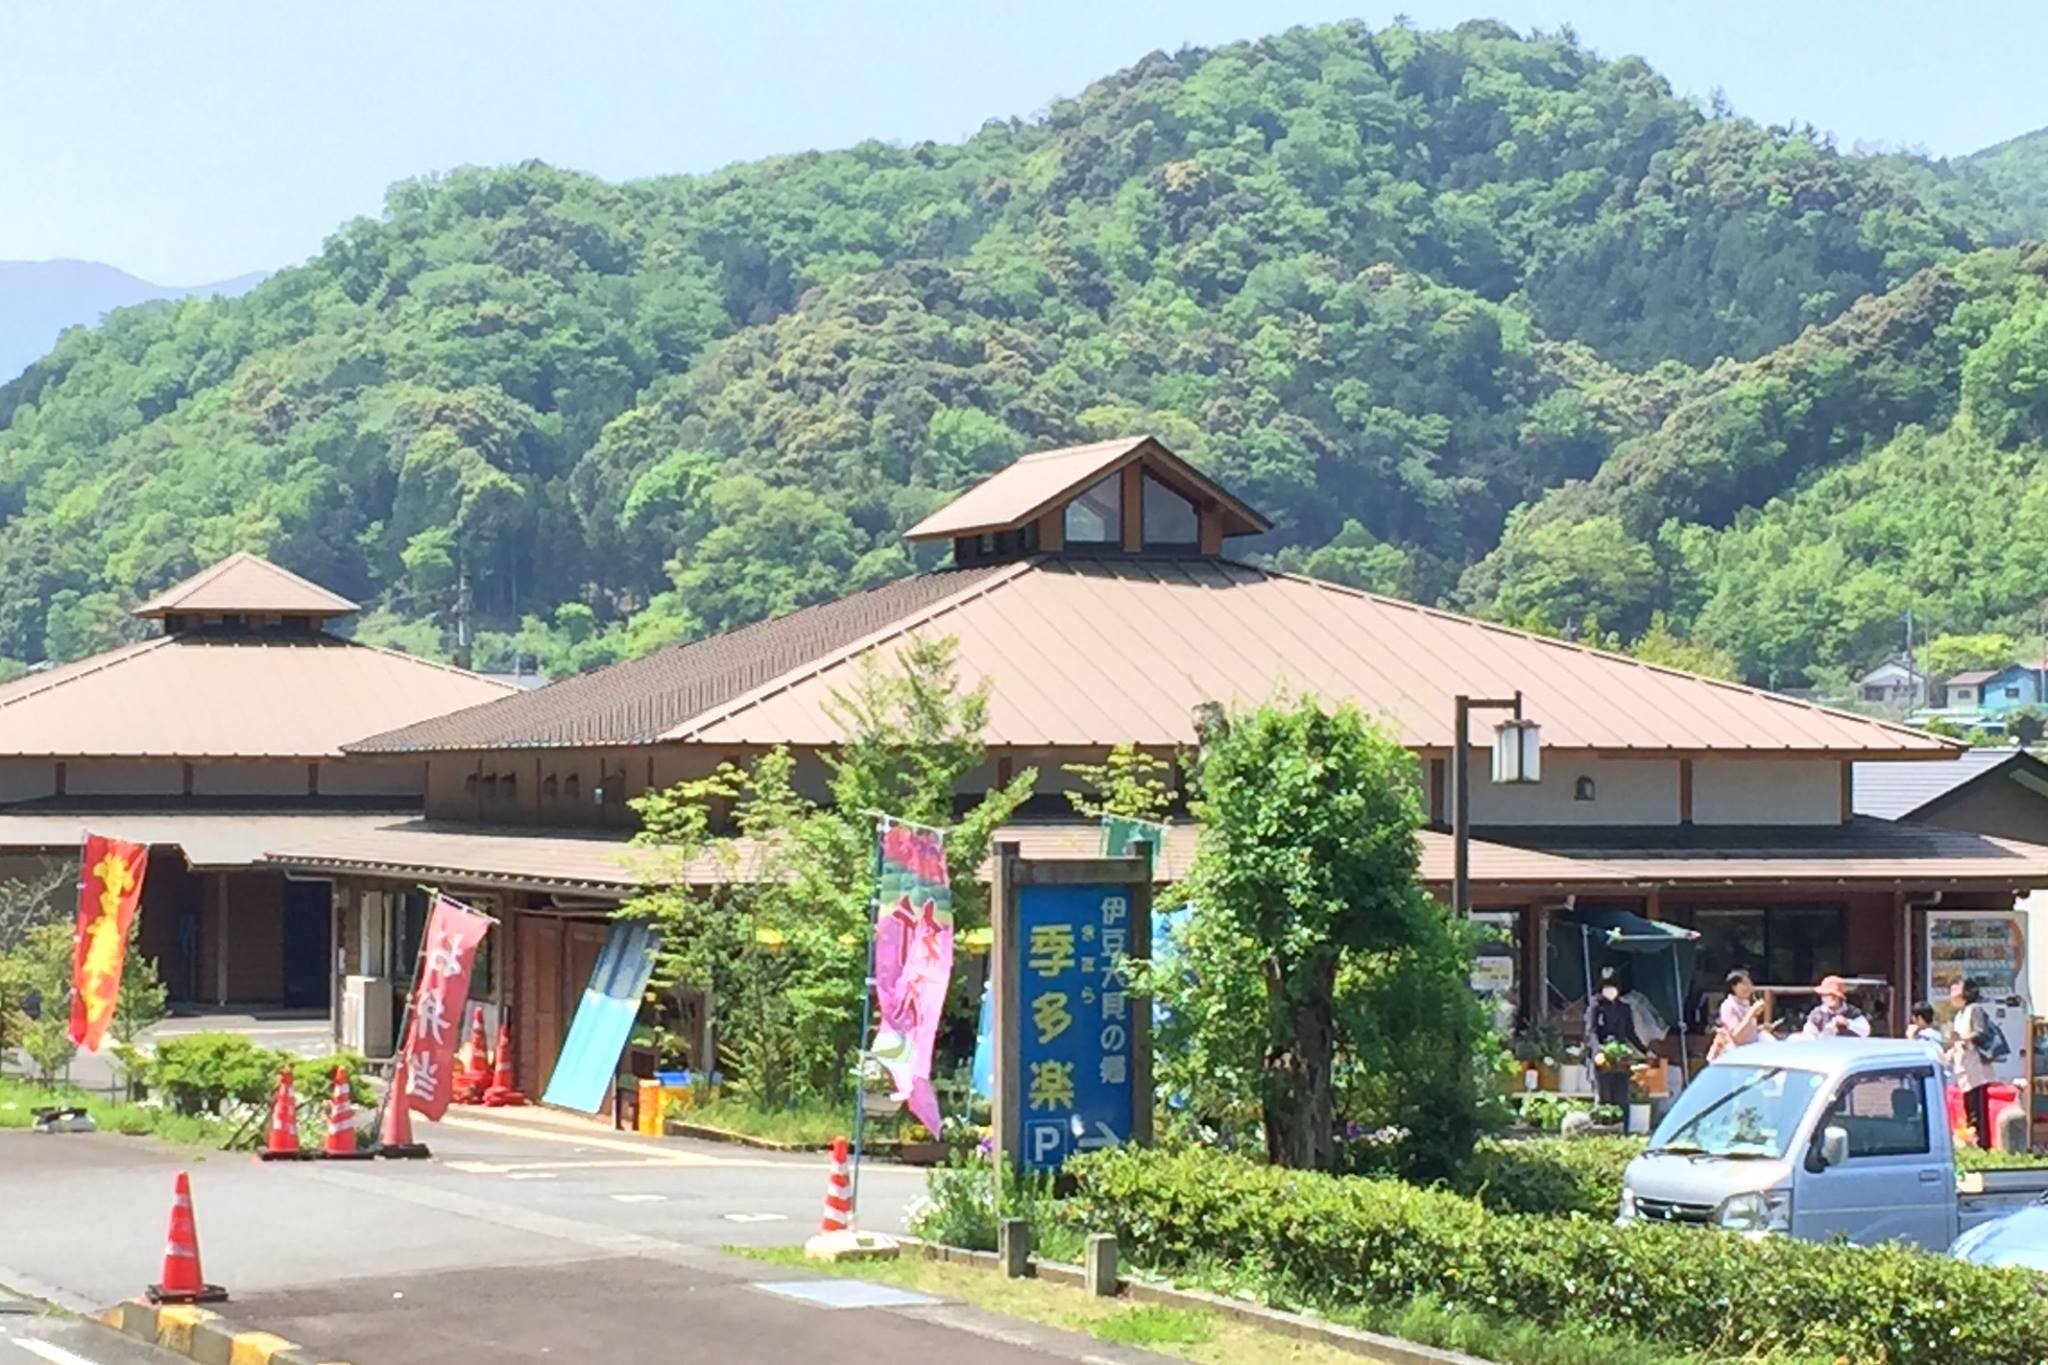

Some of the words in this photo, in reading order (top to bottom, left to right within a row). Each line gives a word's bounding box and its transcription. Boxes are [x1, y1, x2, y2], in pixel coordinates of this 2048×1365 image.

[1029, 924, 1075, 1111] 季多楽
[1035, 1126, 1060, 1162] P
